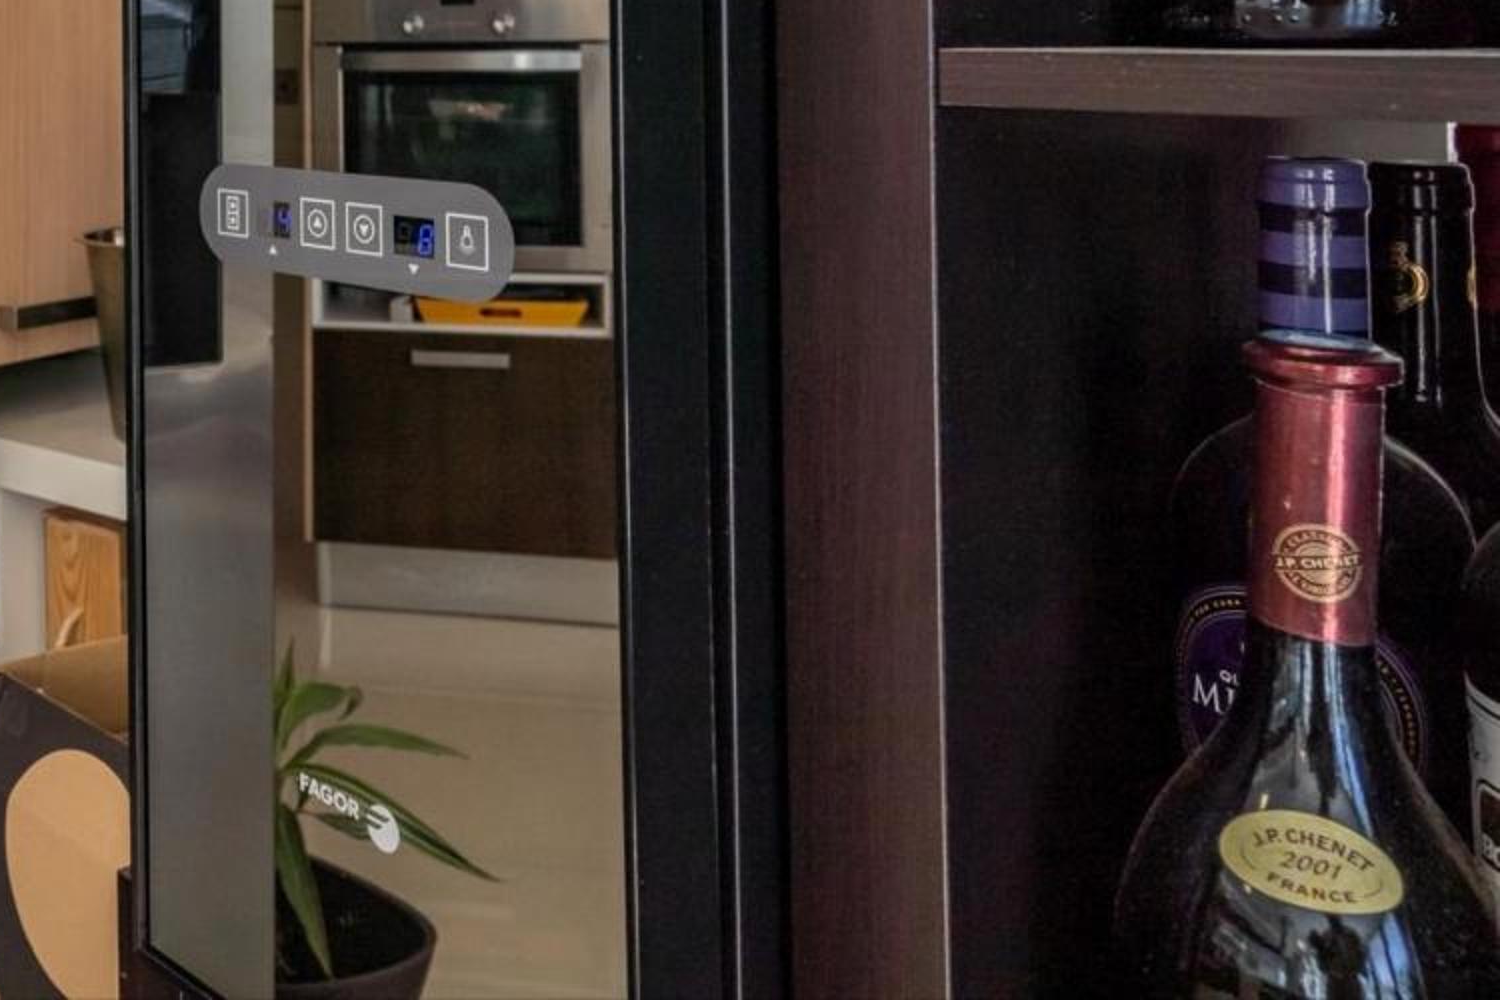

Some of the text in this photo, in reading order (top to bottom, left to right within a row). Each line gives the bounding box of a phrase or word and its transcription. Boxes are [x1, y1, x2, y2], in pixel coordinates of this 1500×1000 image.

[299, 771, 360, 821] FAGOR
[1279, 850, 1342, 880] 2001
[1284, 827, 1375, 872] CHENET
[1266, 871, 1359, 904] FRANCE
